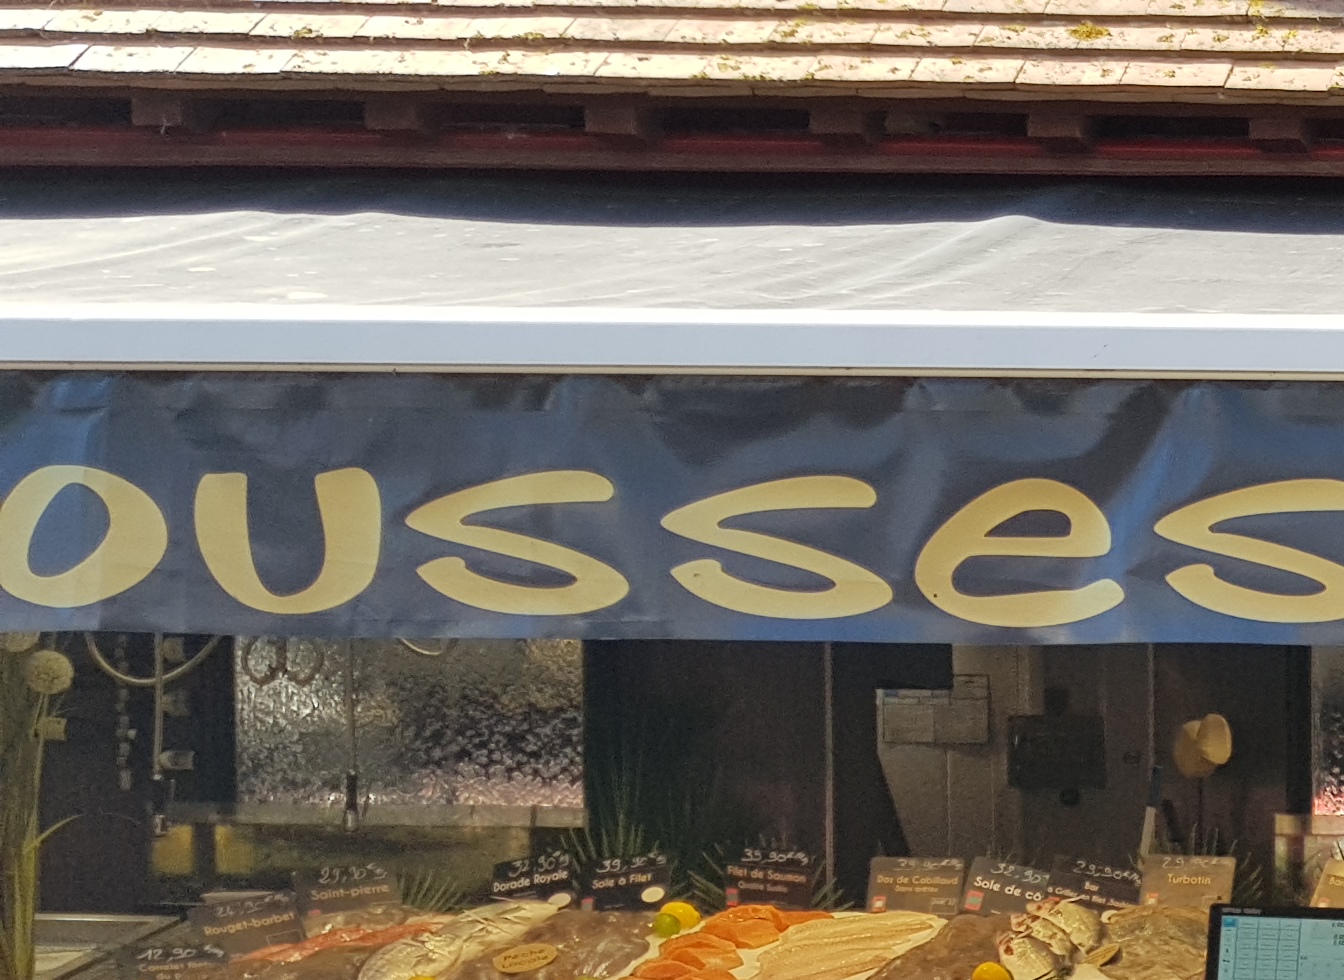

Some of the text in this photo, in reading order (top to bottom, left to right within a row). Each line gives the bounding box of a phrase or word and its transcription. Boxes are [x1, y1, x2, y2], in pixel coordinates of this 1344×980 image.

[493, 870, 568, 893] Dorade Royale
[591, 879, 615, 890] Sole
[629, 873, 652, 884] Filet
[727, 865, 806, 883] Filet de Saumon
[897, 875, 909, 884] de
[1167, 873, 1211, 885] Turbotin
[311, 883, 390, 900] Saint-pierre
[973, 876, 1000, 892] Sole
[1004, 885, 1022, 897] de
[203, 911, 296, 937] Rouget-barbet
